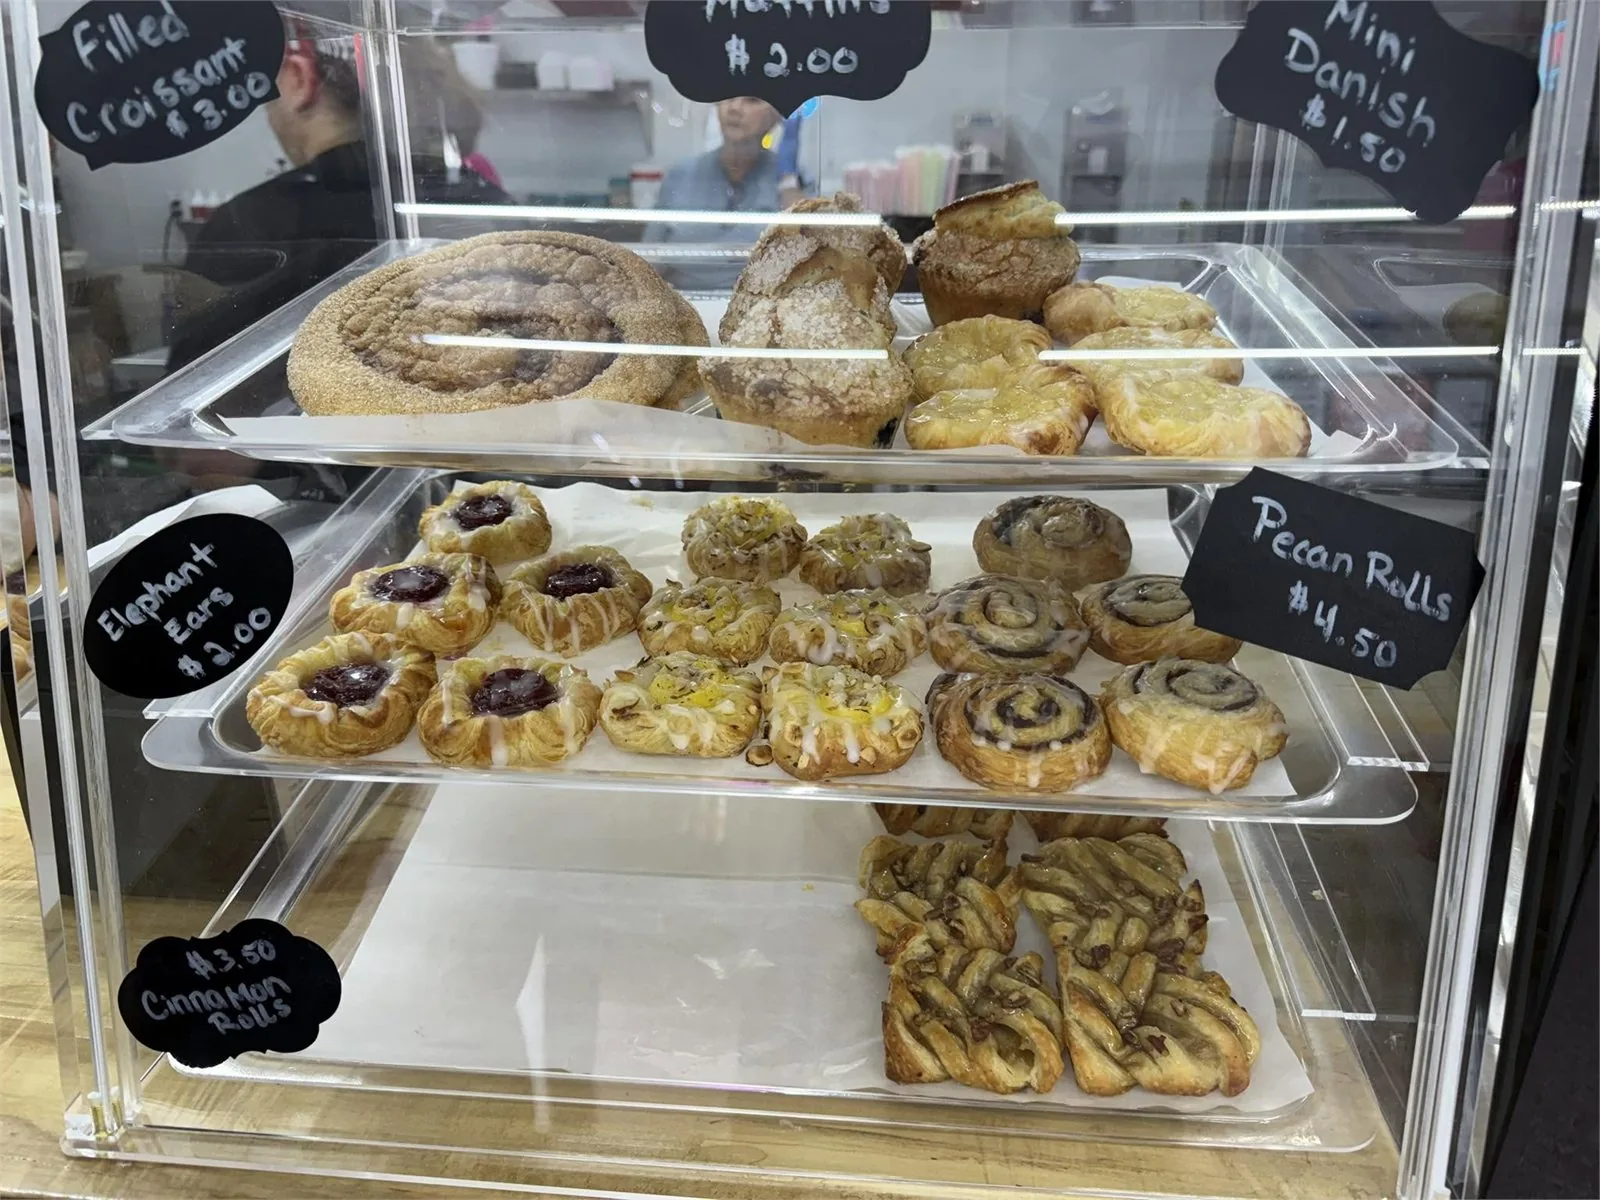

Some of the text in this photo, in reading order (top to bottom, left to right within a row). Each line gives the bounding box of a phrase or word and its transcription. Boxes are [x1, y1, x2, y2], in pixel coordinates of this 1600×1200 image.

[72, 0, 190, 72] Filled
[1325, 0, 1416, 75] Mini
[66, 37, 247, 143] Croissant
[166, 72, 271, 138] $3.00
[1284, 28, 1435, 147] Danish
[1302, 94, 1406, 172] $1.50
[97, 542, 217, 641] Elephant
[1252, 496, 1452, 621] Pecan Rolls
[164, 587, 234, 645] Ears
[178, 607, 271, 679] $2.00
[1288, 580, 1396, 668] $4.50
[186, 939, 276, 980] $3.50
[208, 999, 291, 1034] Rolls
